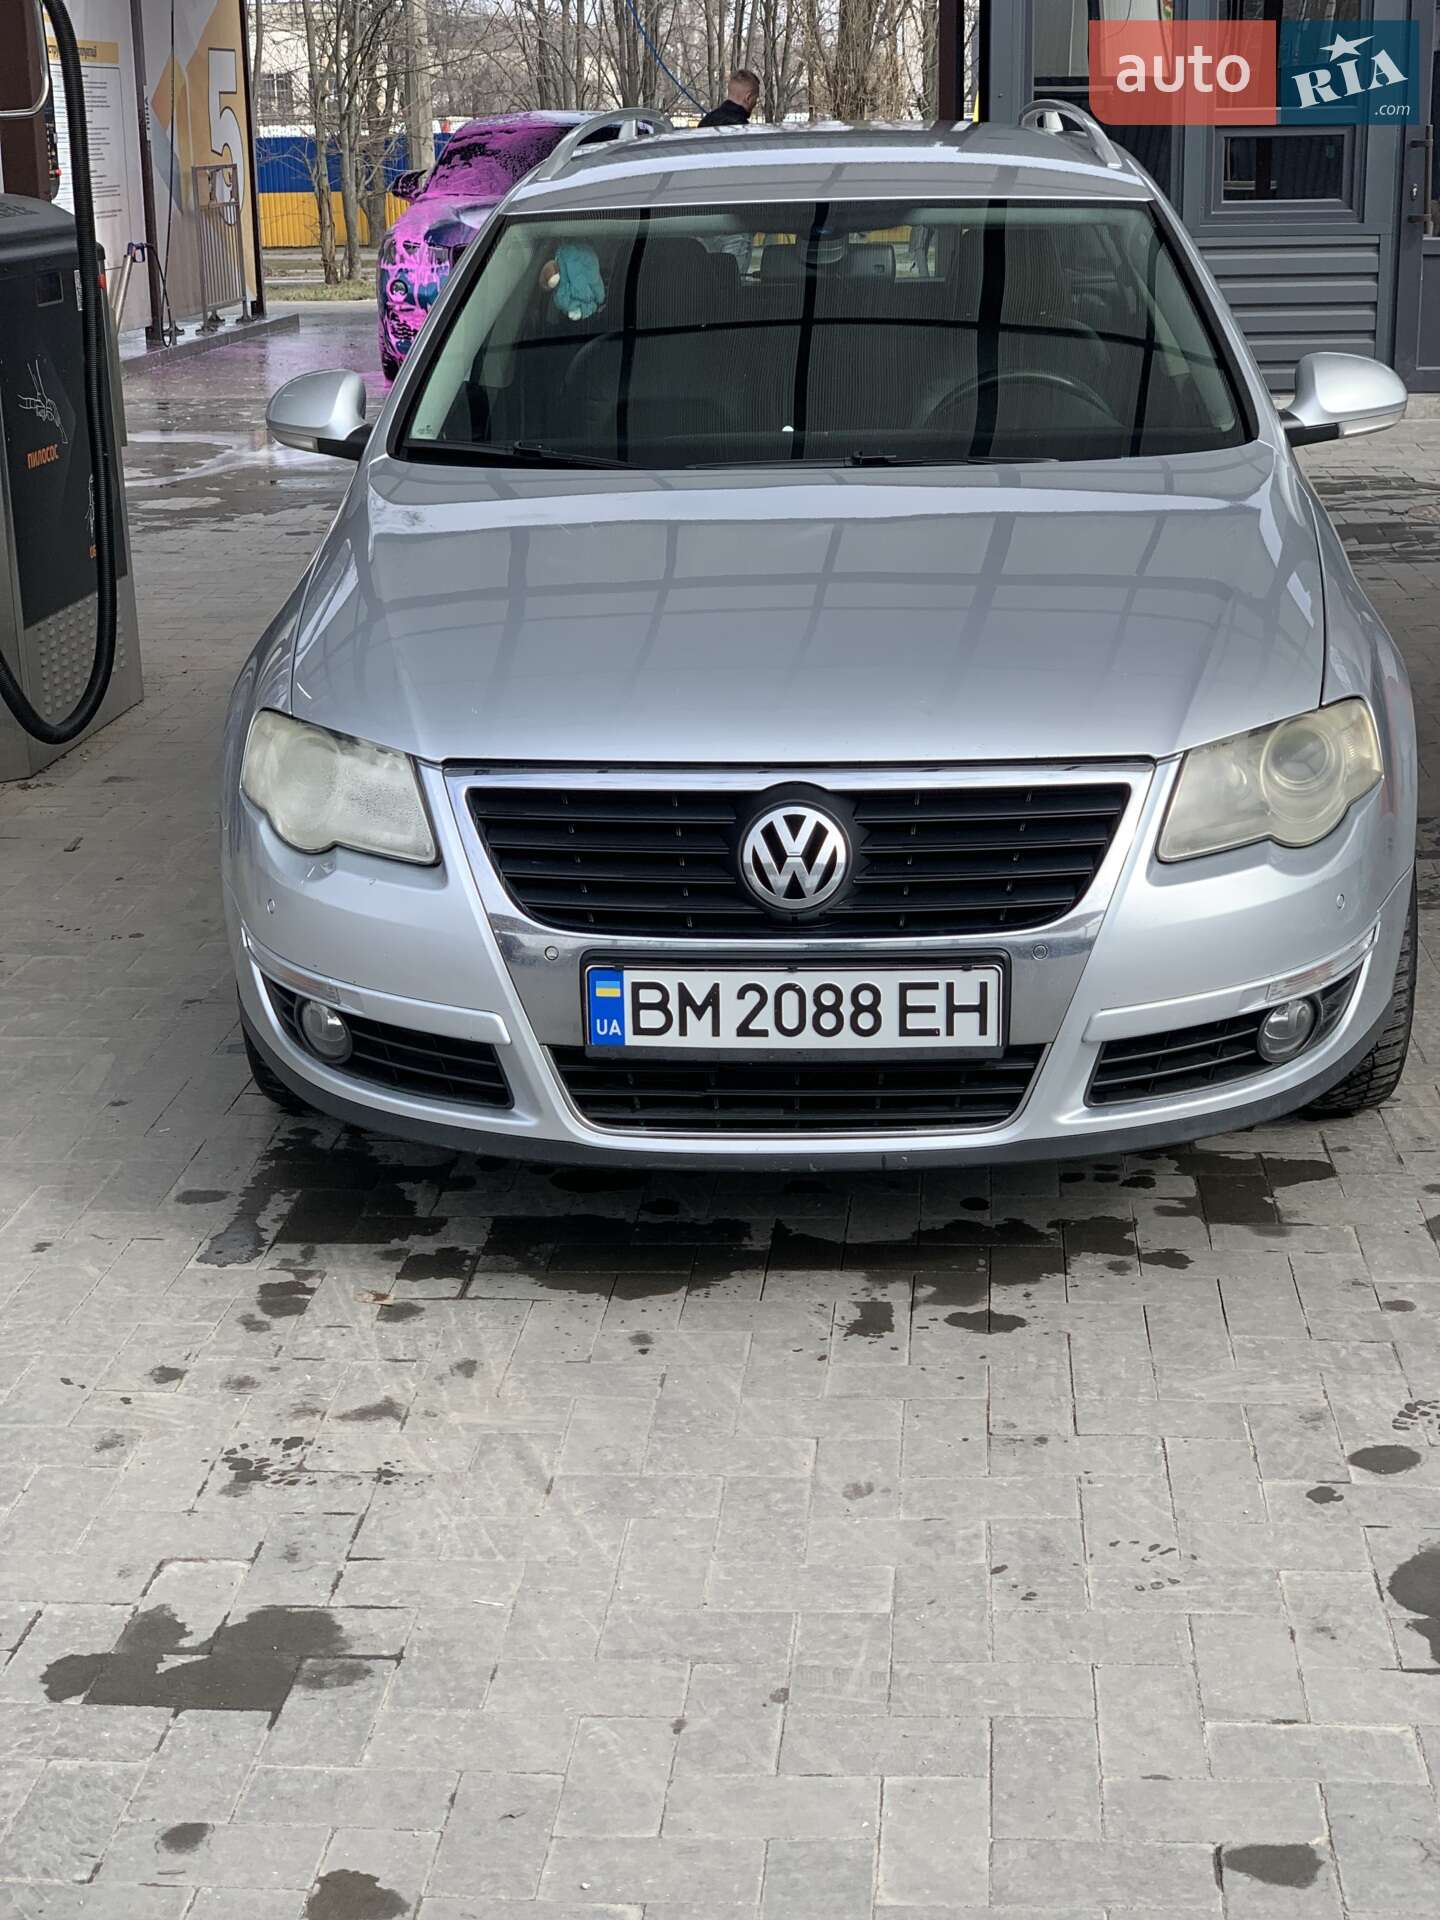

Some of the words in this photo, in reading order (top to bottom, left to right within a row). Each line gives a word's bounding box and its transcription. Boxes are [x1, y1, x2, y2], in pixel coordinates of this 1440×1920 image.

[207, 47, 245, 216] 5
[27, 443, 59, 469] ПИЛОСОС
[596, 1018, 621, 1037] UA
[631, 981, 720, 1038] BM
[736, 982, 883, 1038] 2088
[899, 981, 988, 1038] EH
